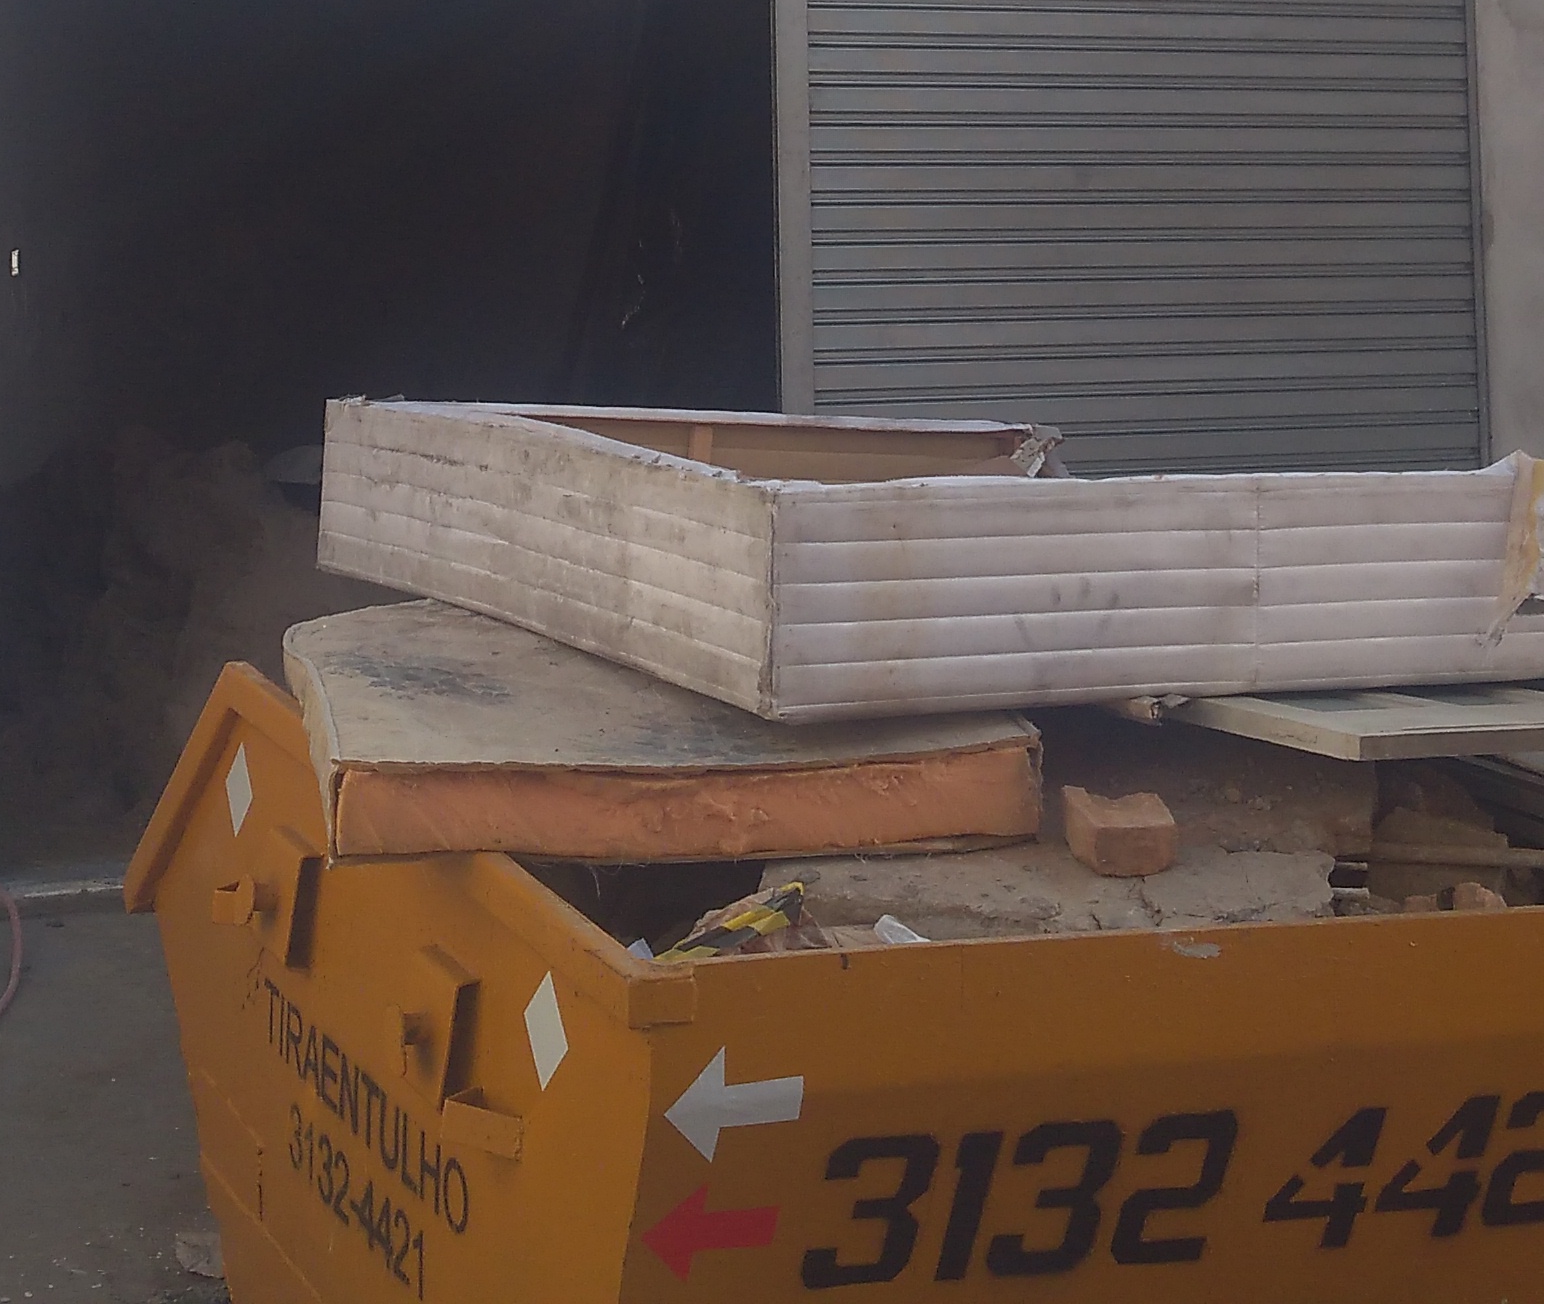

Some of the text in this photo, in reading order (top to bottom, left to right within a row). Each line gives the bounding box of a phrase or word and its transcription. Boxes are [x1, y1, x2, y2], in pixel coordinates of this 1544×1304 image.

[265, 978, 469, 1234] TIRAENTULHO
[289, 1102, 423, 1302] 3132-4421
[800, 1108, 1238, 1290] 3132
